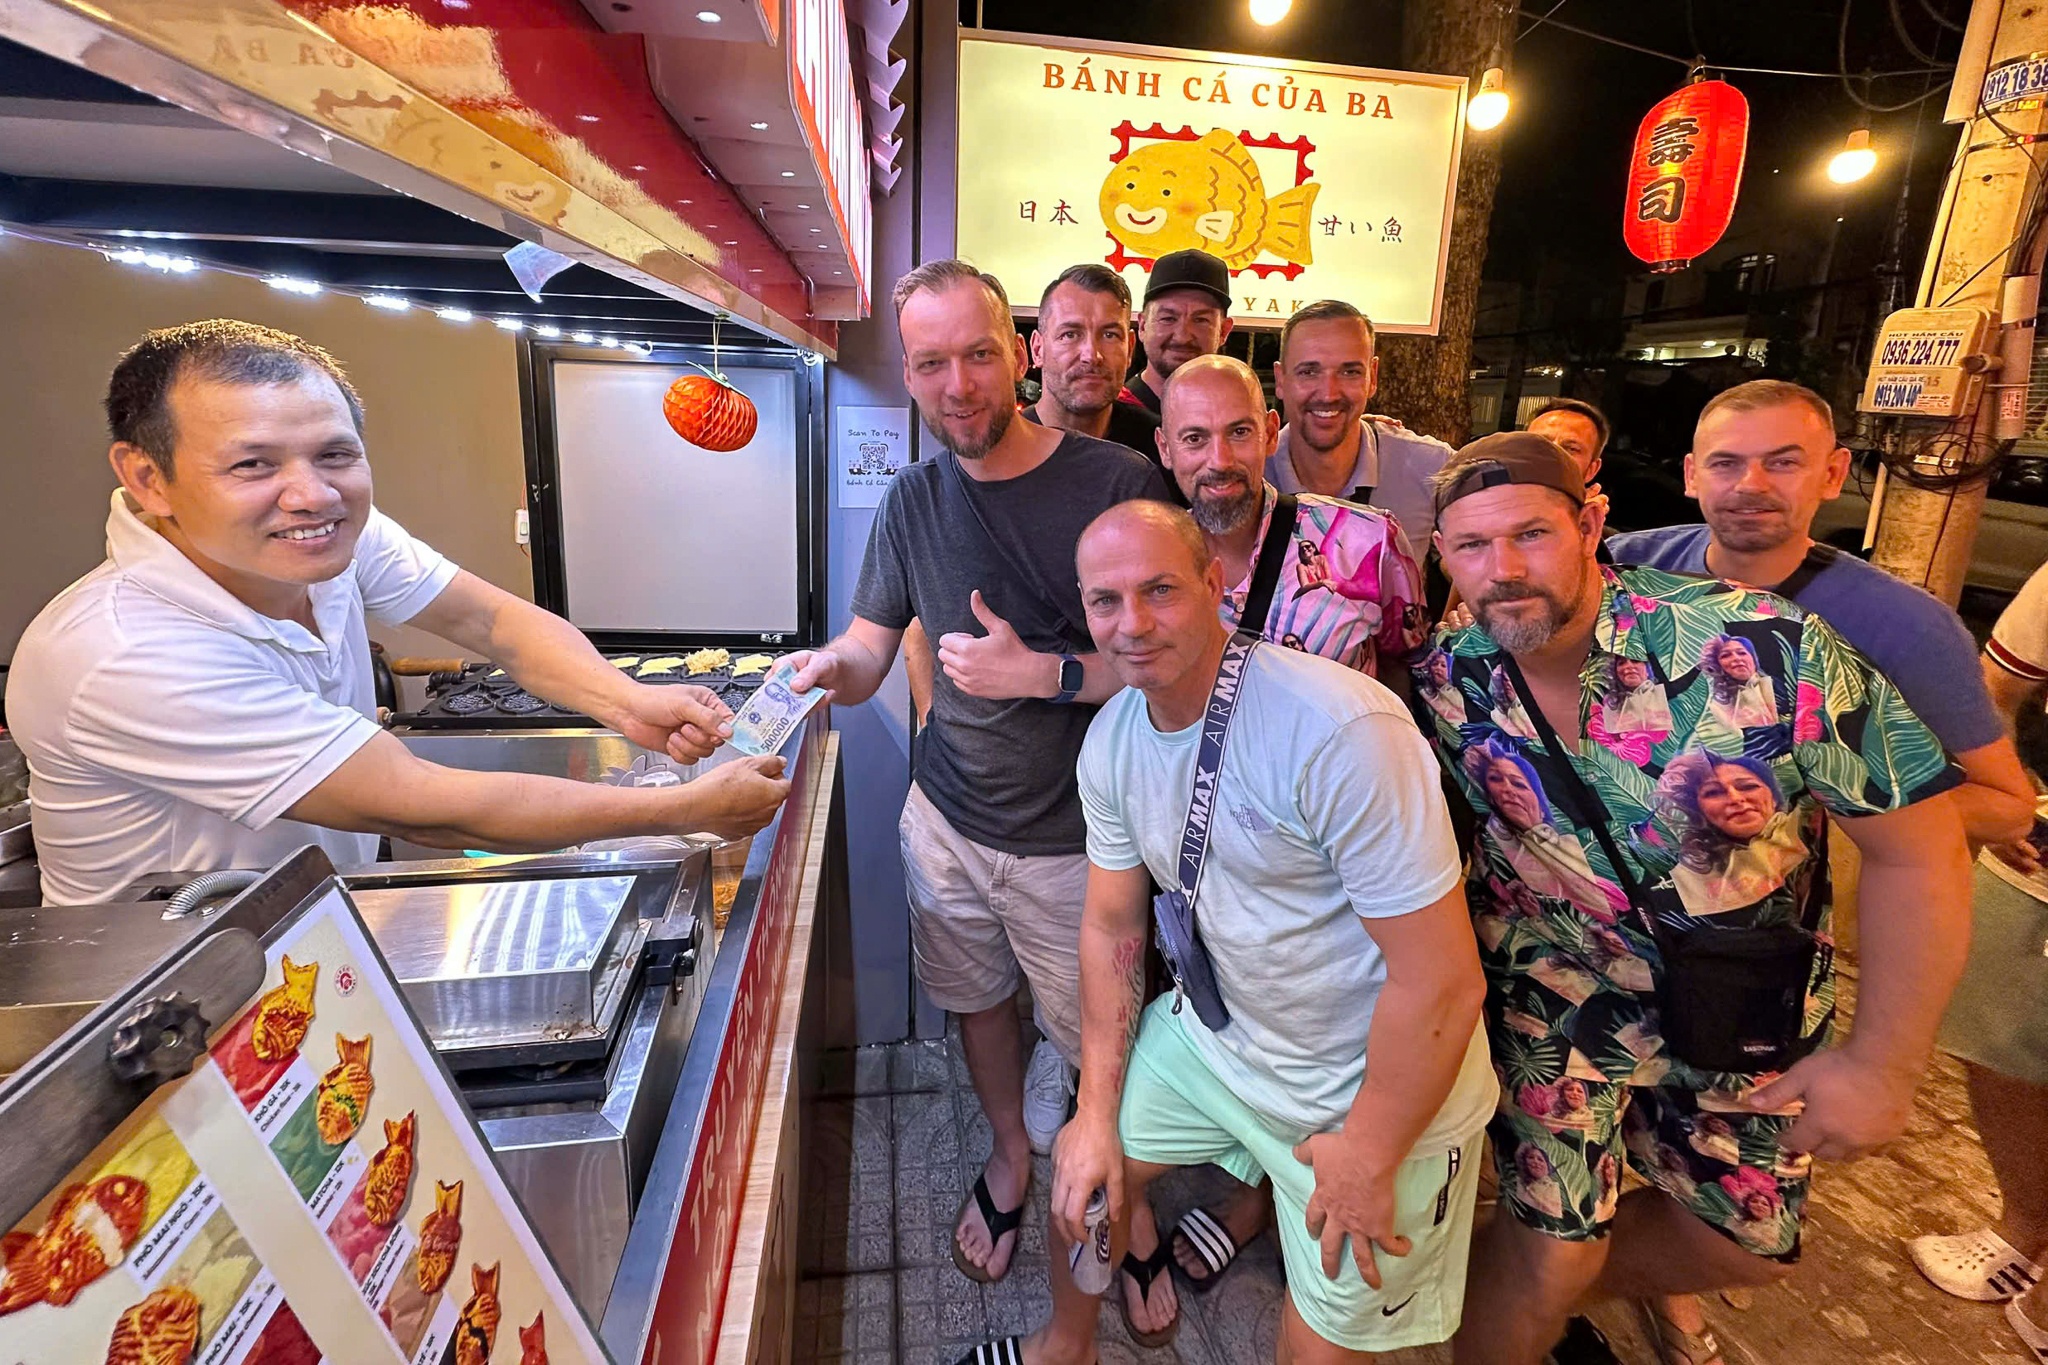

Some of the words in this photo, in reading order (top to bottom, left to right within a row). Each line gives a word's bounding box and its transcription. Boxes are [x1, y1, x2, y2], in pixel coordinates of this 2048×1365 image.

[1043, 57, 1161, 98] BÁNH
[1183, 71, 1231, 104] CÁ
[1252, 76, 1327, 114] CỦA
[1346, 92, 1394, 120] BA
[1019, 198, 1079, 226] 日本
[1317, 215, 1403, 244] 甘い魚
[1881, 339, 1961, 366] 0936.224.777
[847, 429, 867, 437] Scan
[871, 429, 881, 437] To
[884, 429, 900, 440] Pay
[760, 716, 790, 753] 500000
